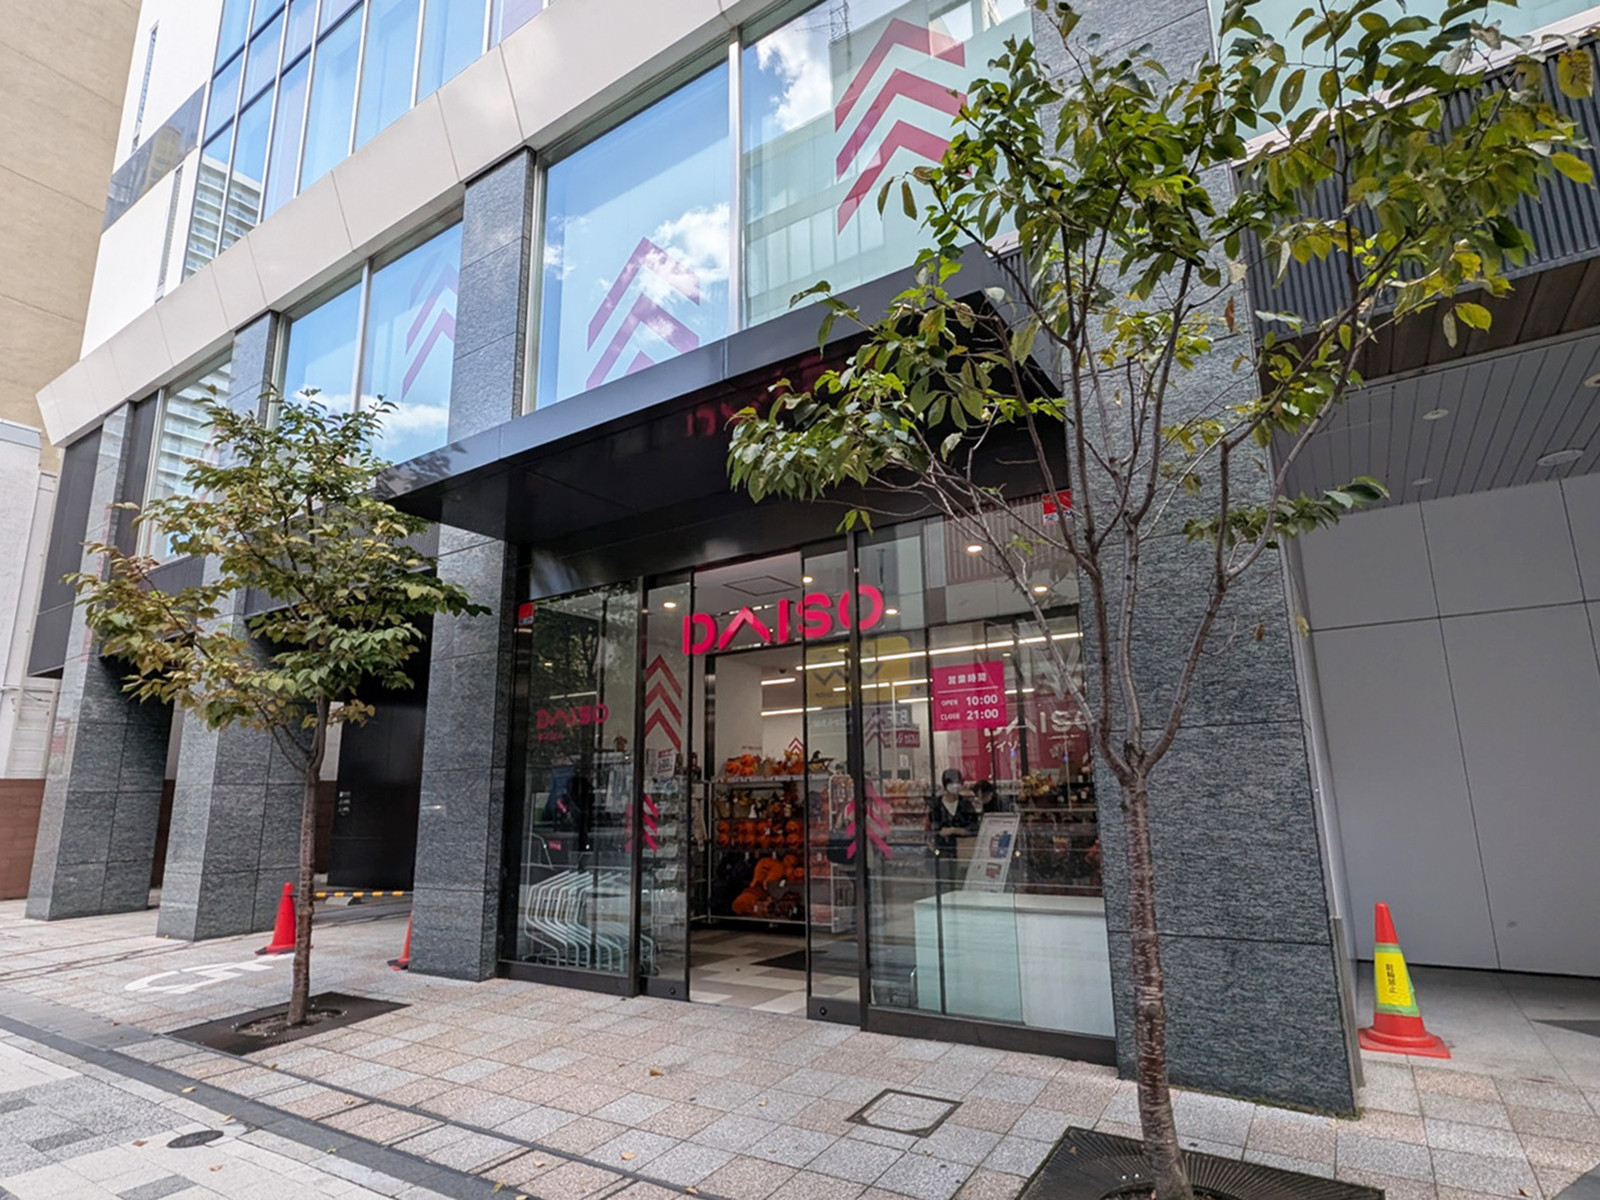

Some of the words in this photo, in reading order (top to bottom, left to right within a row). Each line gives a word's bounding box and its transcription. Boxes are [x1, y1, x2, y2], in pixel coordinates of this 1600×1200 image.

[682, 584, 884, 655] DAISO
[948, 672, 986, 685] 営業時間
[941, 699, 958, 707] OPEN
[966, 694, 998, 706] 10:00
[537, 703, 610, 729] DAISO
[967, 708, 999, 720] 21:00
